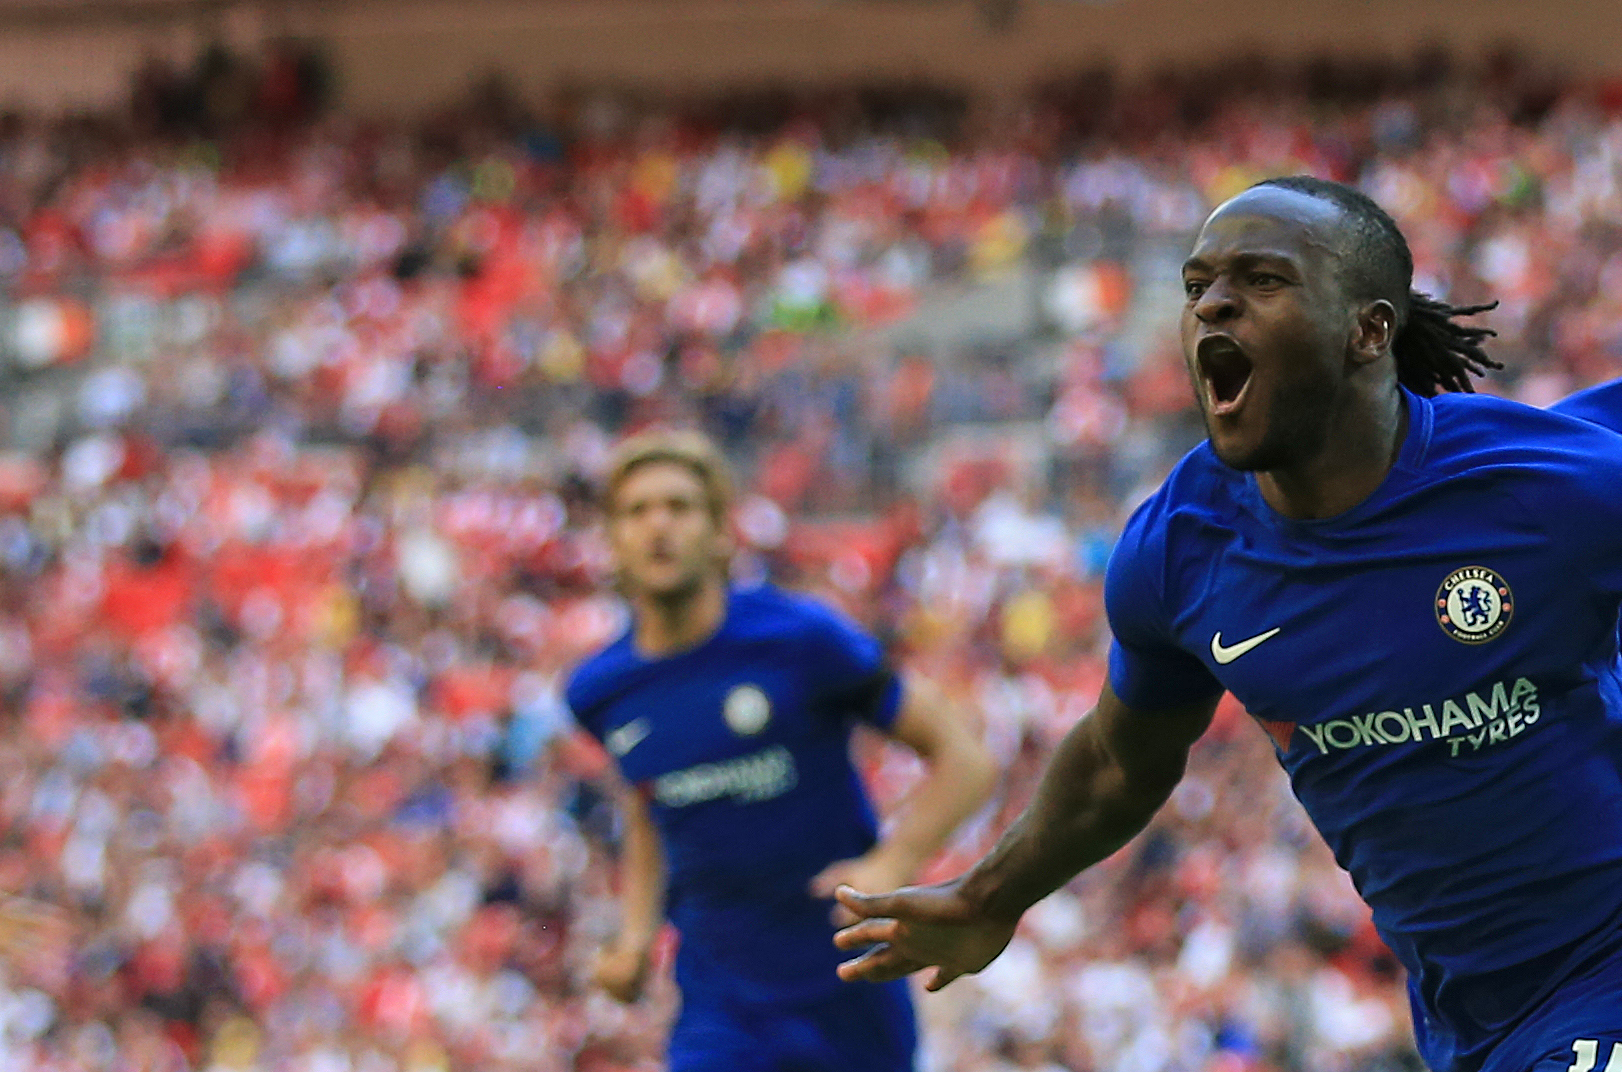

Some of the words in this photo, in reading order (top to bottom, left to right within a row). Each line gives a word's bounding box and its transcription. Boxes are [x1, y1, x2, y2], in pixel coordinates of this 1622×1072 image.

[1444, 569, 1493, 590] CHELSEA
[1299, 677, 1538, 755] YOKOHAMA
[1446, 694, 1541, 757] TYRES
